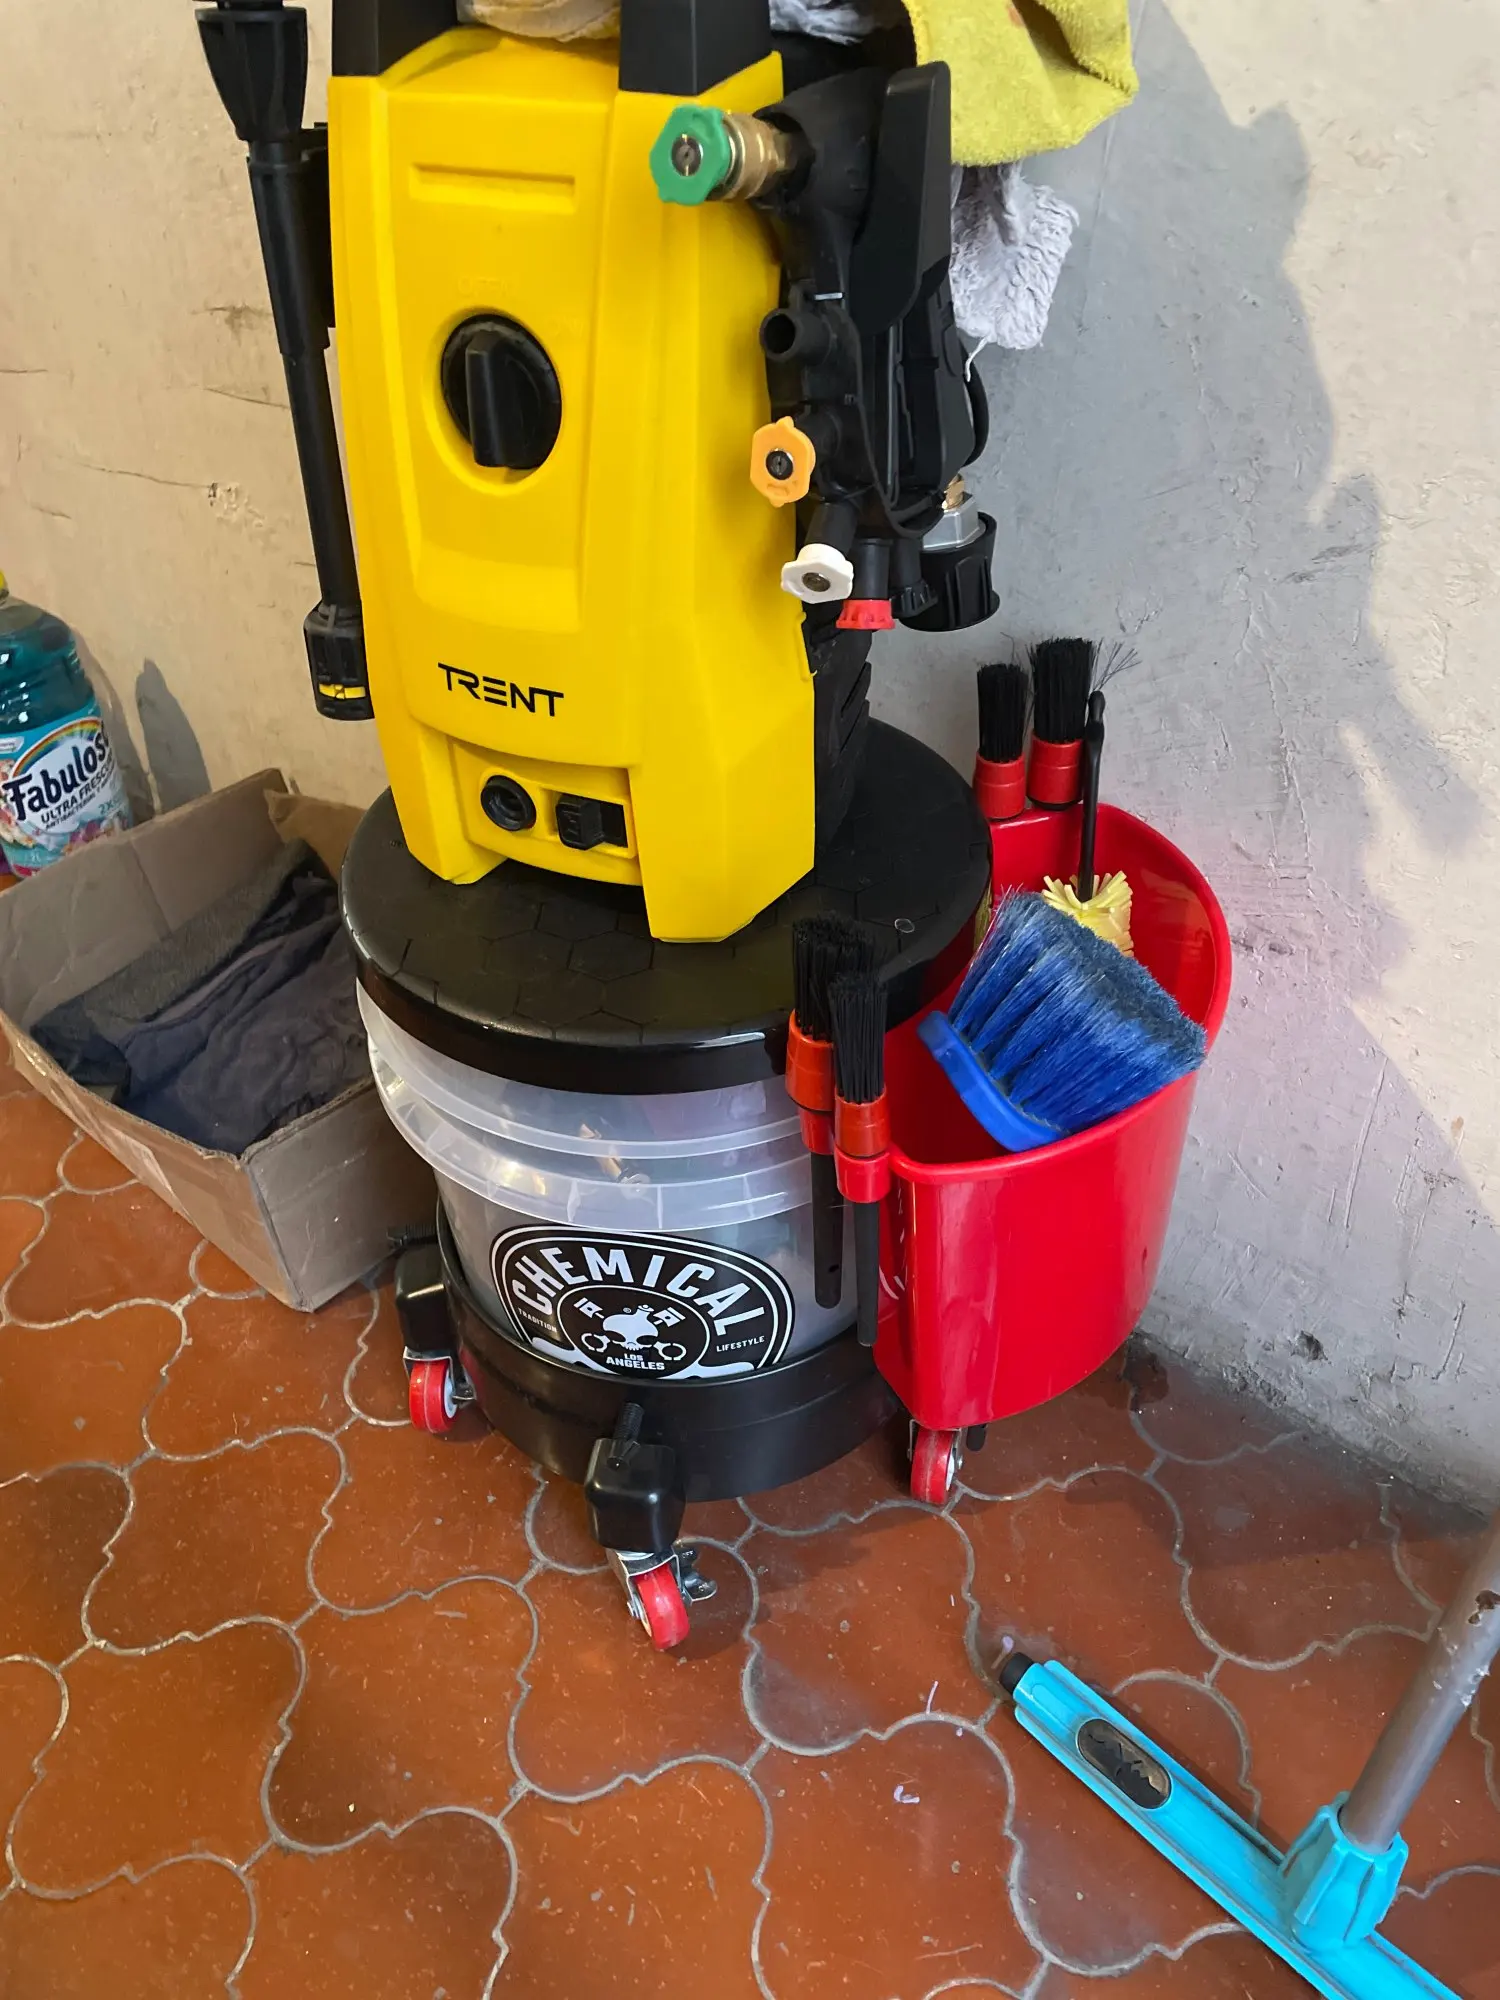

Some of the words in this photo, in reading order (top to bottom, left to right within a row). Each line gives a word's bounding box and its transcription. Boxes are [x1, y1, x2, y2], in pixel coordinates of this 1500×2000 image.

[437, 661, 564, 717] TRENT
[41, 796, 78, 823] ULTRA
[511, 1246, 765, 1336] CHEMICAL
[517, 1307, 557, 1333] TRADITION
[716, 1335, 765, 1353] LIFESTYLE
[605, 1356, 665, 1371] ANGELES
[624, 1353, 644, 1362] LOS
